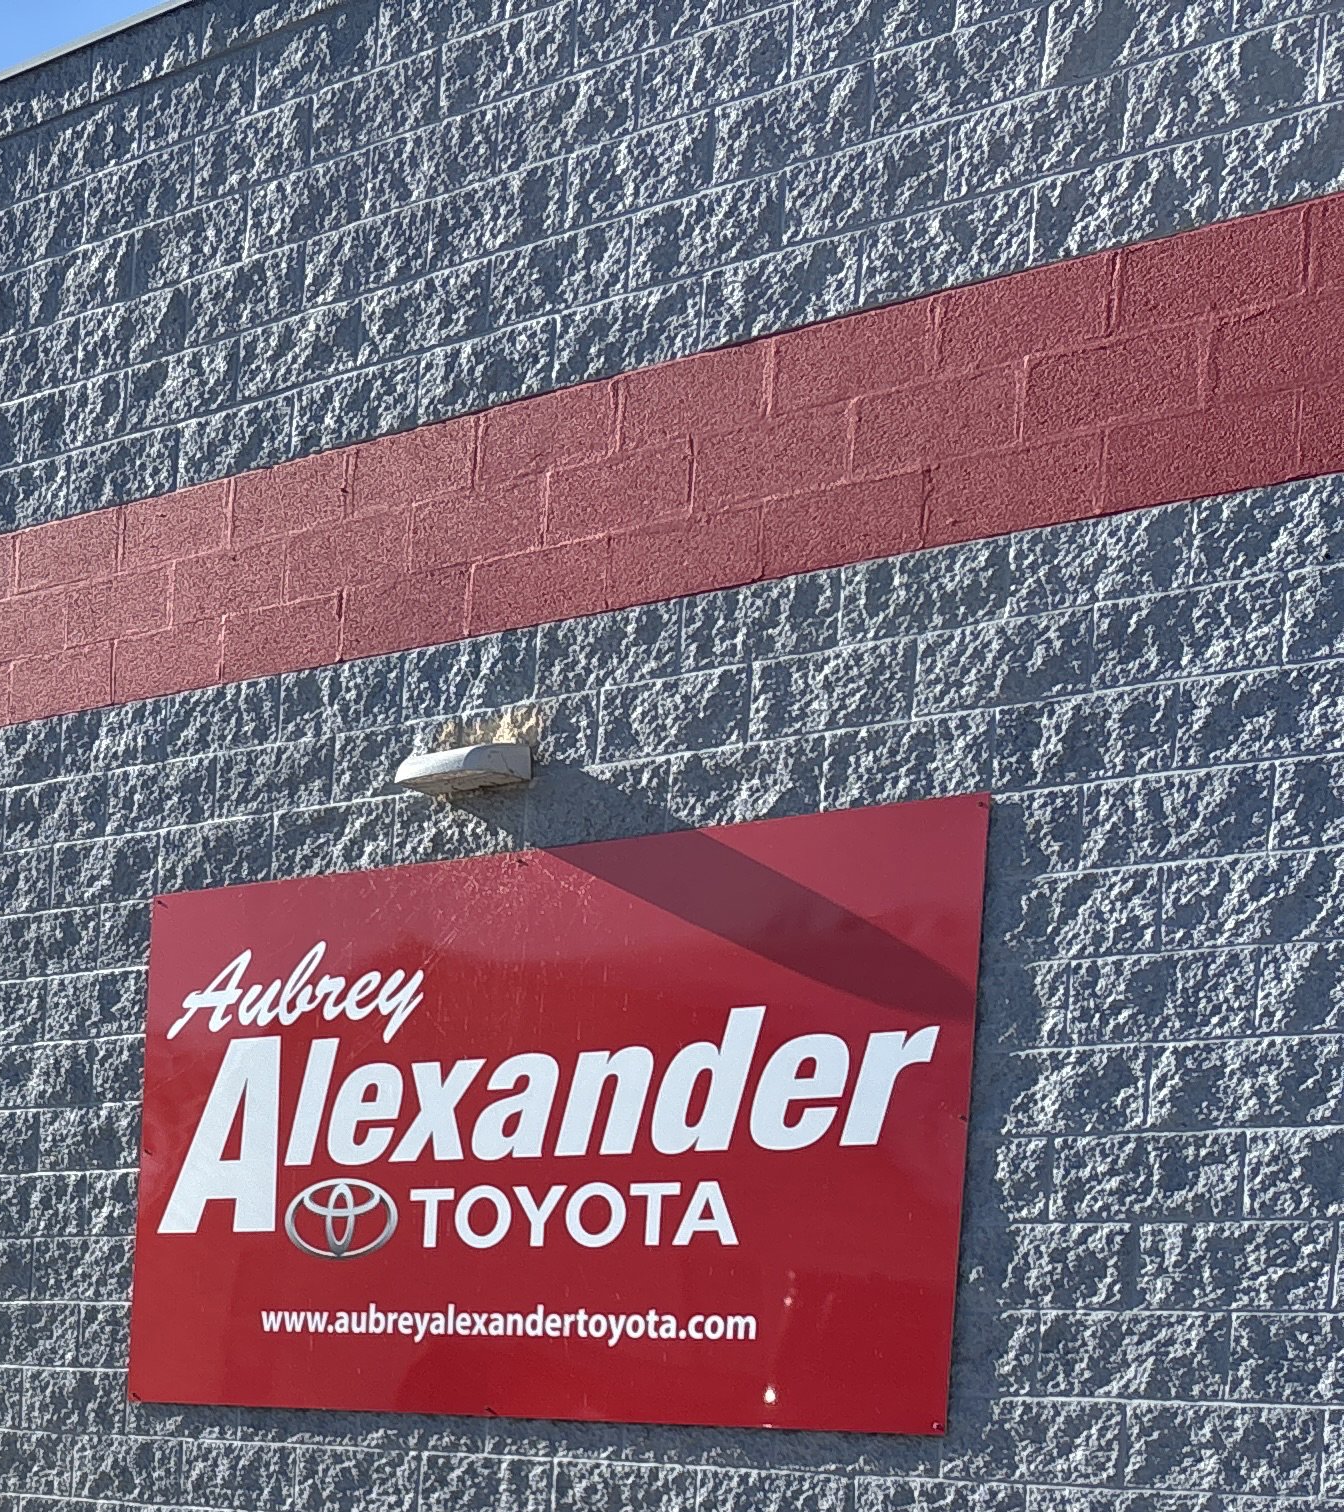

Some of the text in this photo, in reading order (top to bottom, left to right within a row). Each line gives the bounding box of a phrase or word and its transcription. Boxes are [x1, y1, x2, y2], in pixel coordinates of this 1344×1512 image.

[167, 940, 425, 1044] Aubrey
[157, 1006, 940, 1234] Alexander
[410, 1181, 739, 1248] TOYOTA
[260, 1303, 757, 1346] www.aubreyalexandertoyota.com
